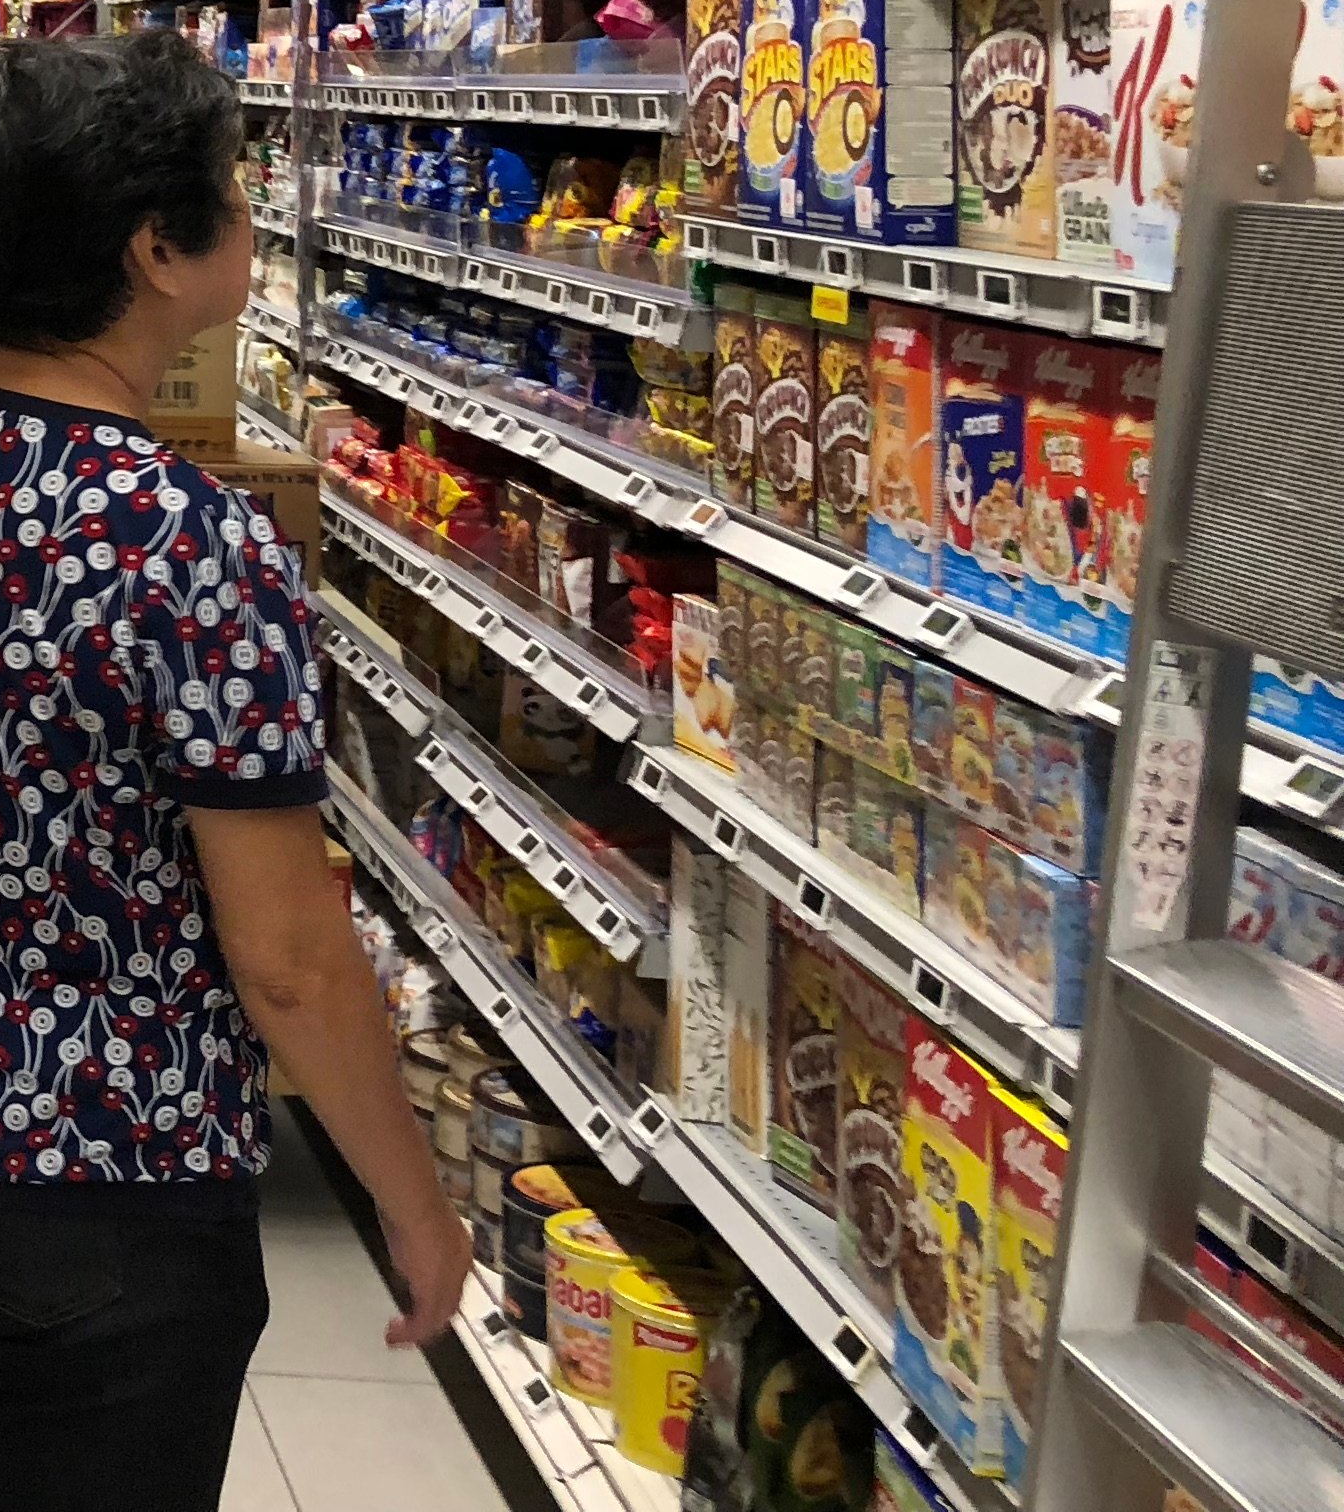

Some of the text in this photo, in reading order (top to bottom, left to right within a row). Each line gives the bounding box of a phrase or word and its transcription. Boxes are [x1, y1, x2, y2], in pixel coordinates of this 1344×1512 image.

[741, 43, 803, 124] STARS
[808, 43, 876, 122] STARS
[1114, 4, 1174, 207] K
